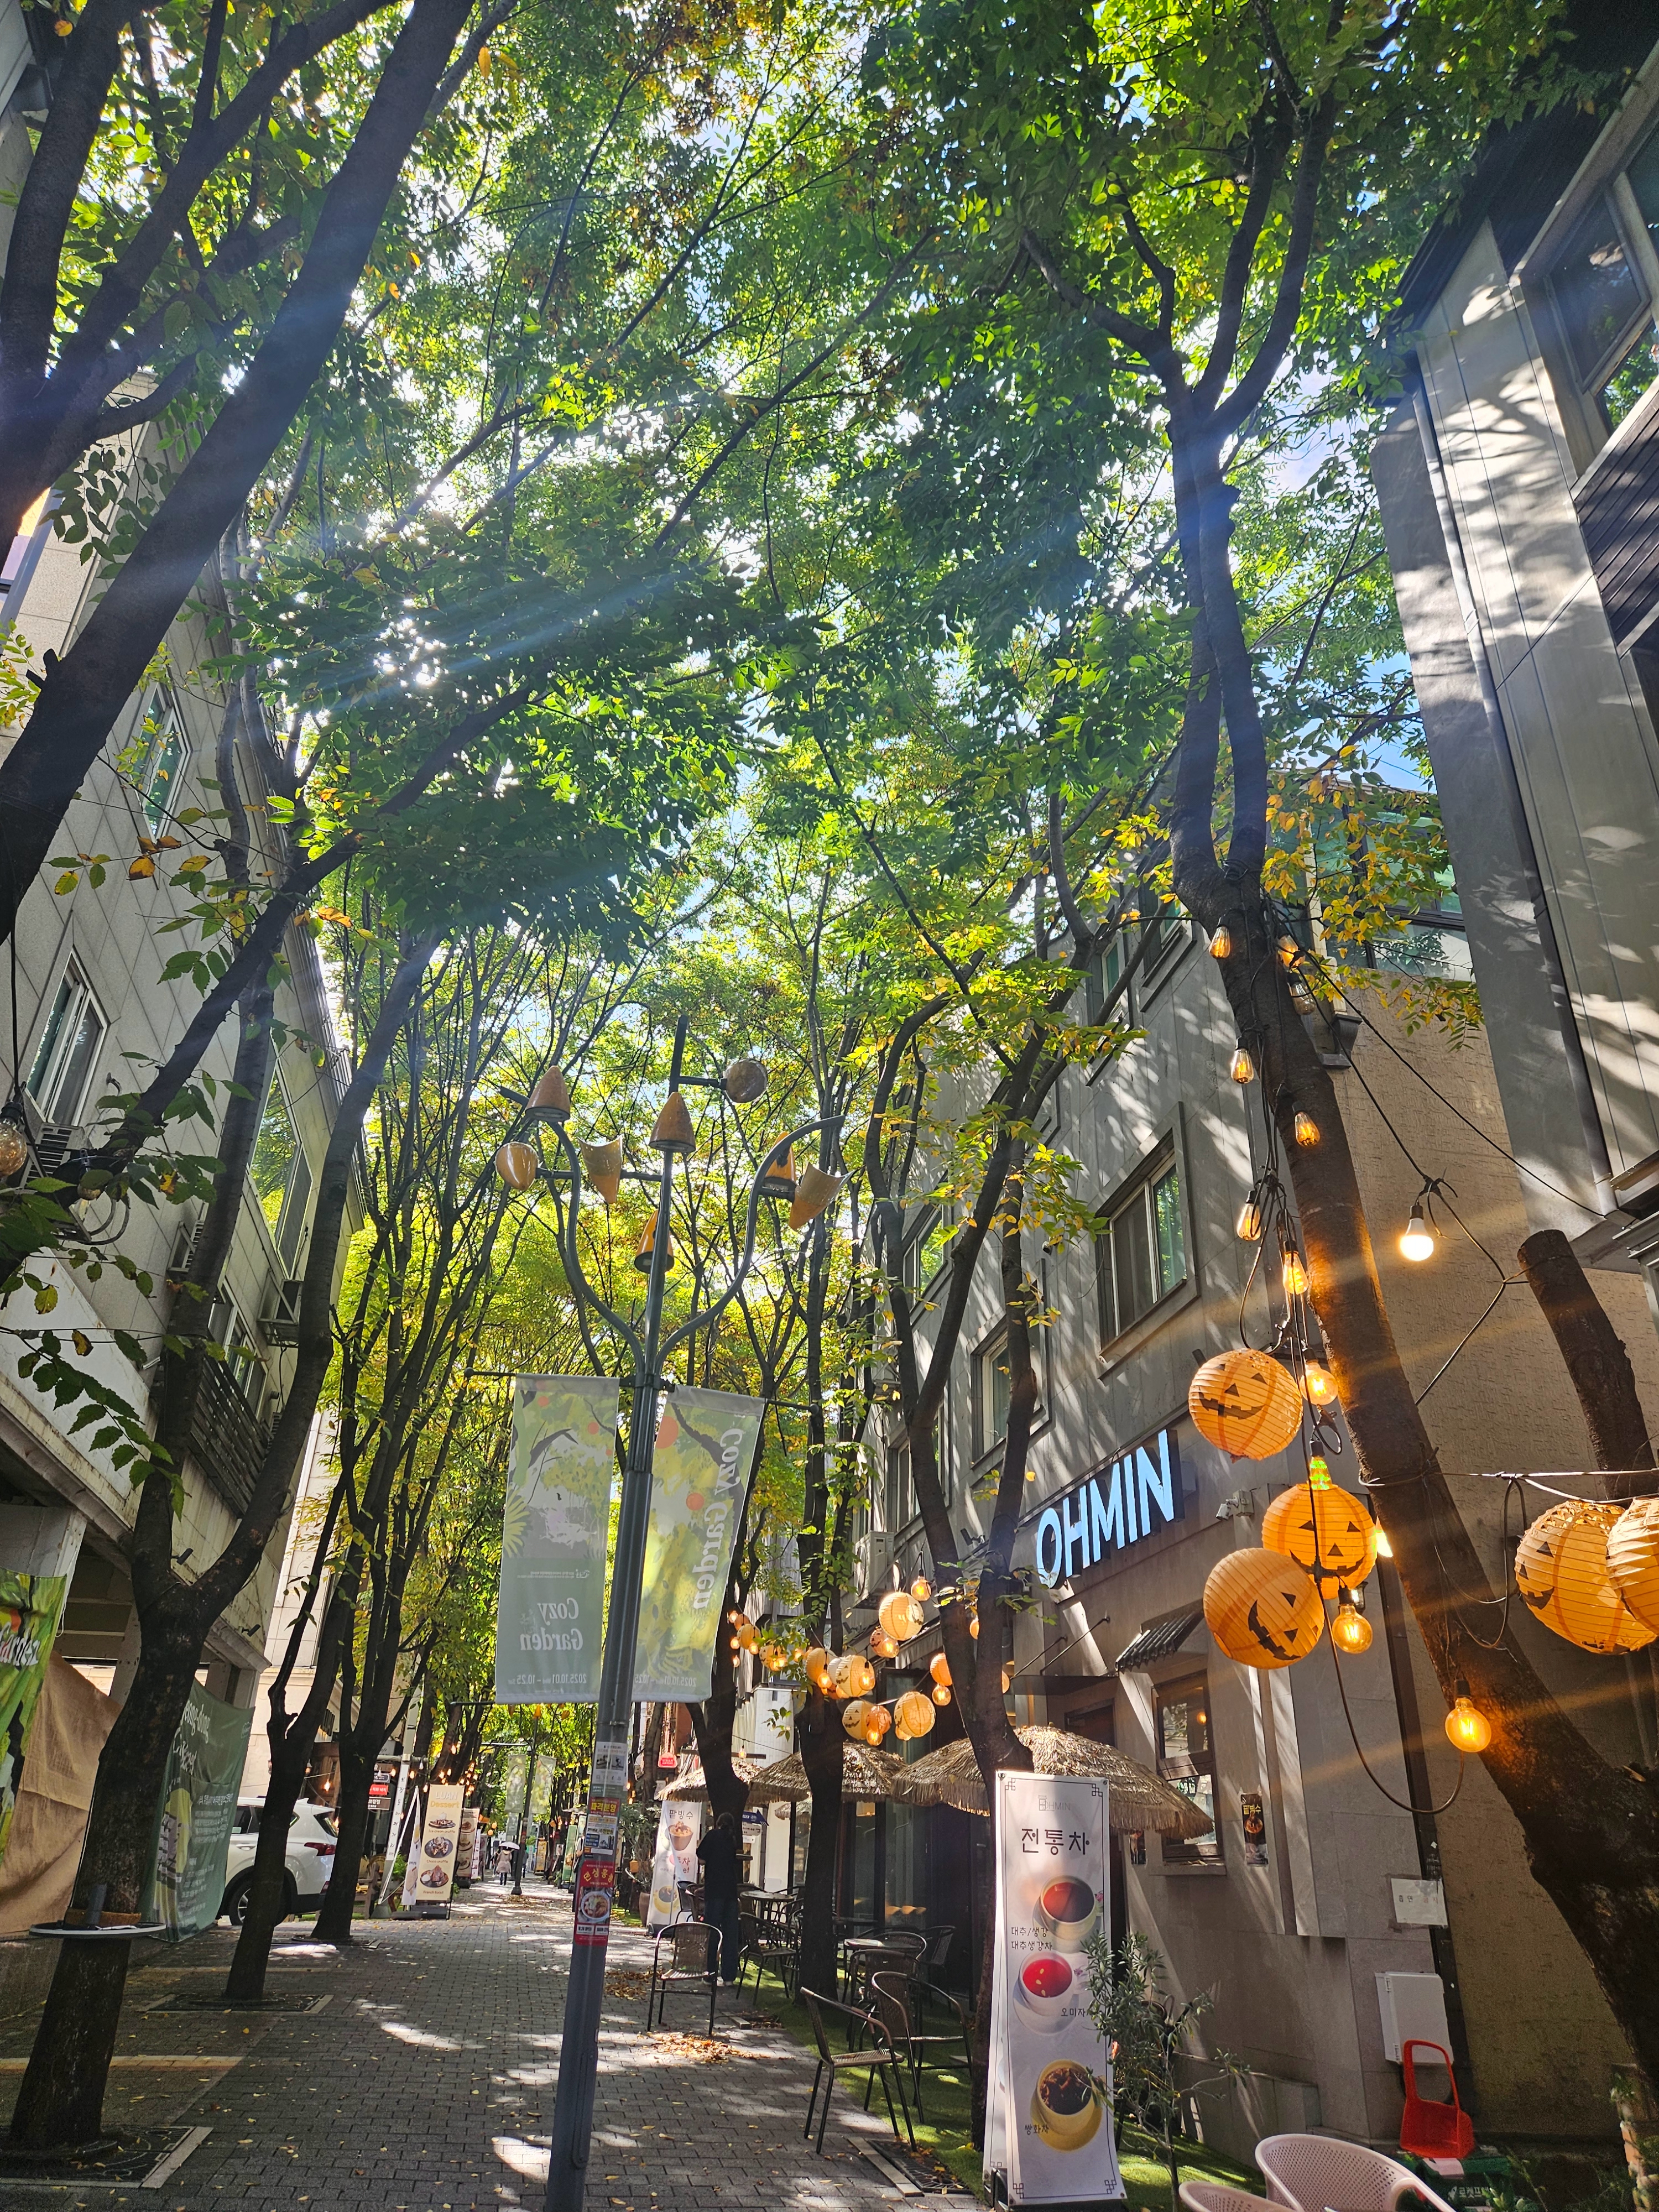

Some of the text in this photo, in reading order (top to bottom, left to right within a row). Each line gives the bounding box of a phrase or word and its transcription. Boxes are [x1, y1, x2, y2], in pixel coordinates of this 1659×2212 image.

[1036, 1429, 1175, 1589] OHMIN
[669, 1809, 693, 1820] 팥빙수
[1021, 1828, 1090, 1855] 전통차
[1011, 1927, 1049, 1938] 대추/생강
[1011, 1940, 1052, 1951] 대추생강차
